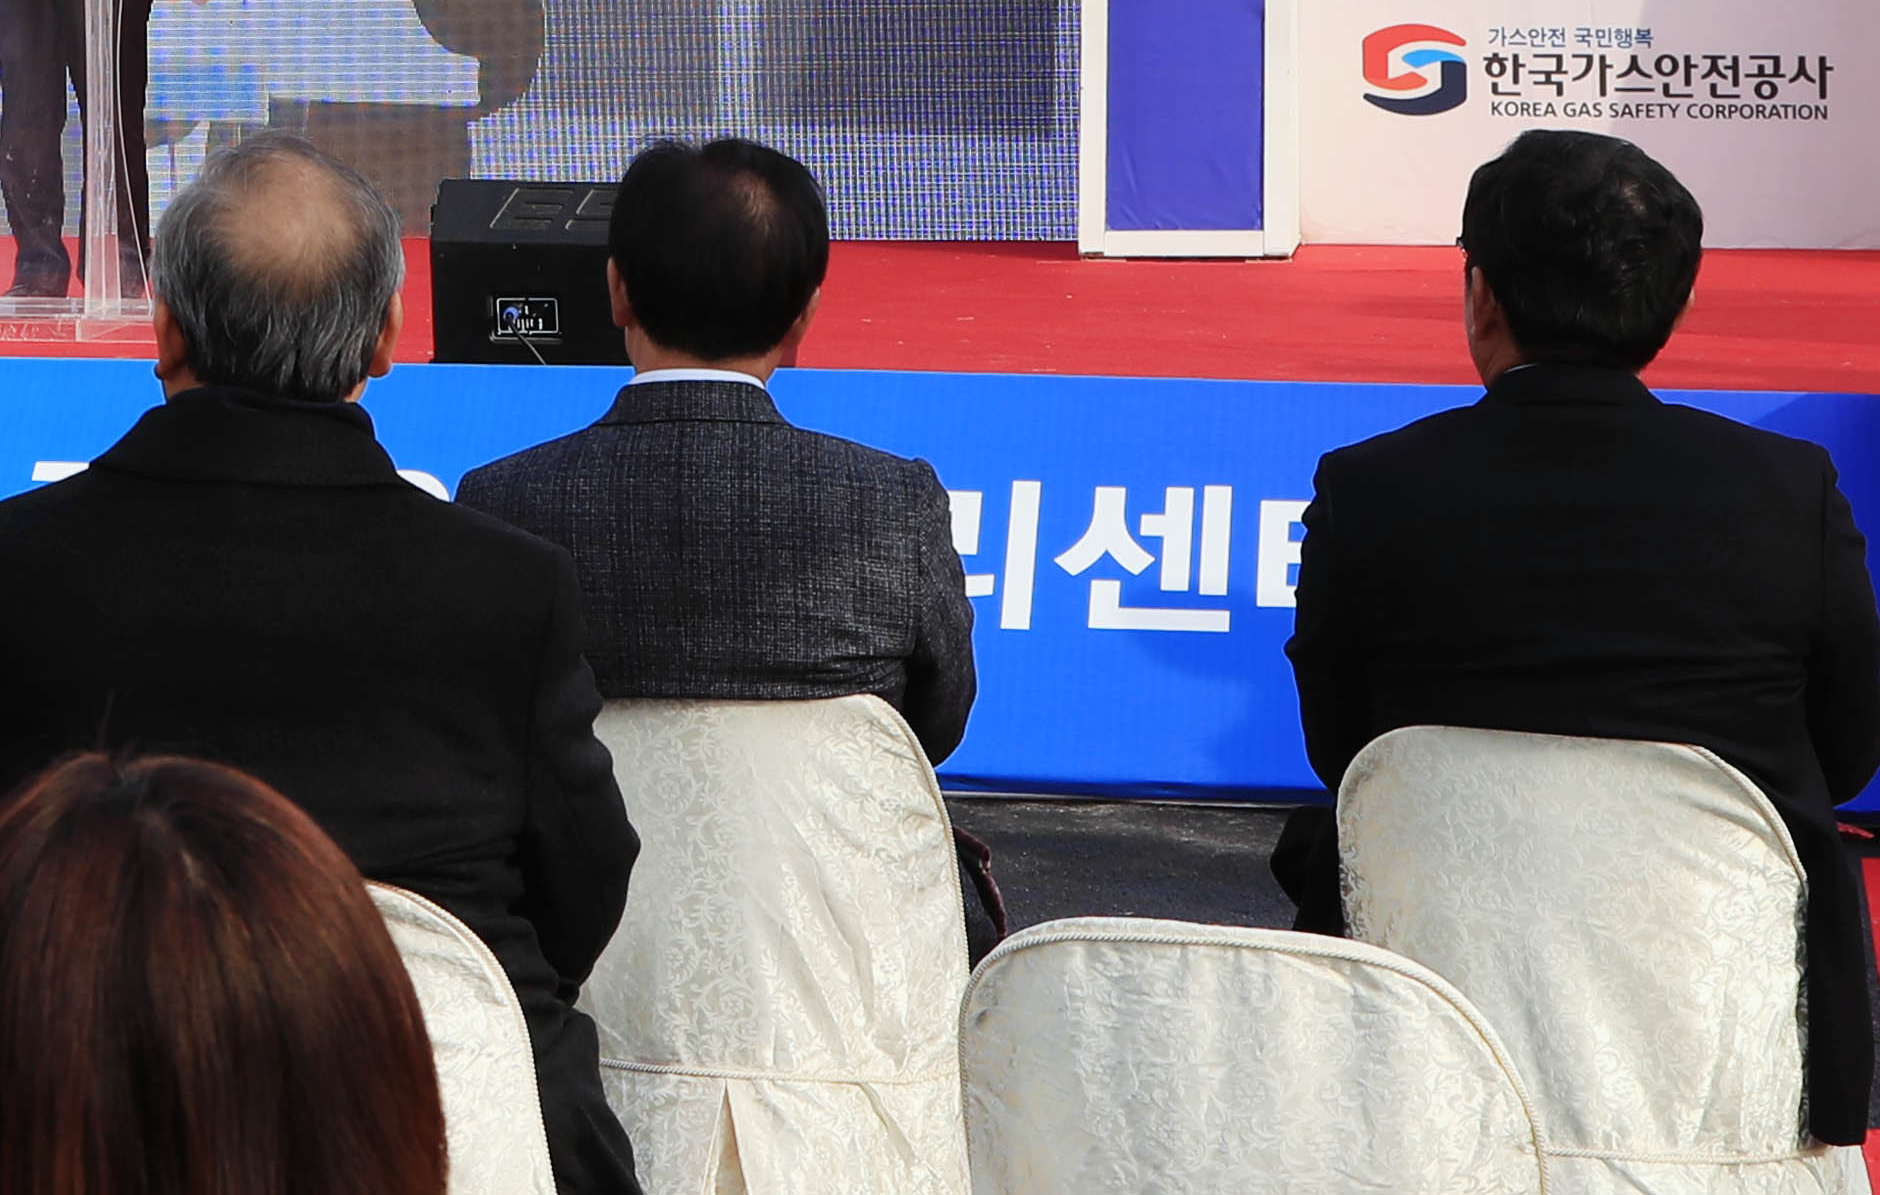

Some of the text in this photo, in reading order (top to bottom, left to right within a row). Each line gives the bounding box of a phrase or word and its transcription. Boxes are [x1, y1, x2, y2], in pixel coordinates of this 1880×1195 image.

[1488, 26, 1655, 49] 가스안전 국민행복
[1483, 53, 1834, 100] 한국가스안전공사
[1491, 102, 1829, 120] KOREA GAS SAFETY CORPORATION
